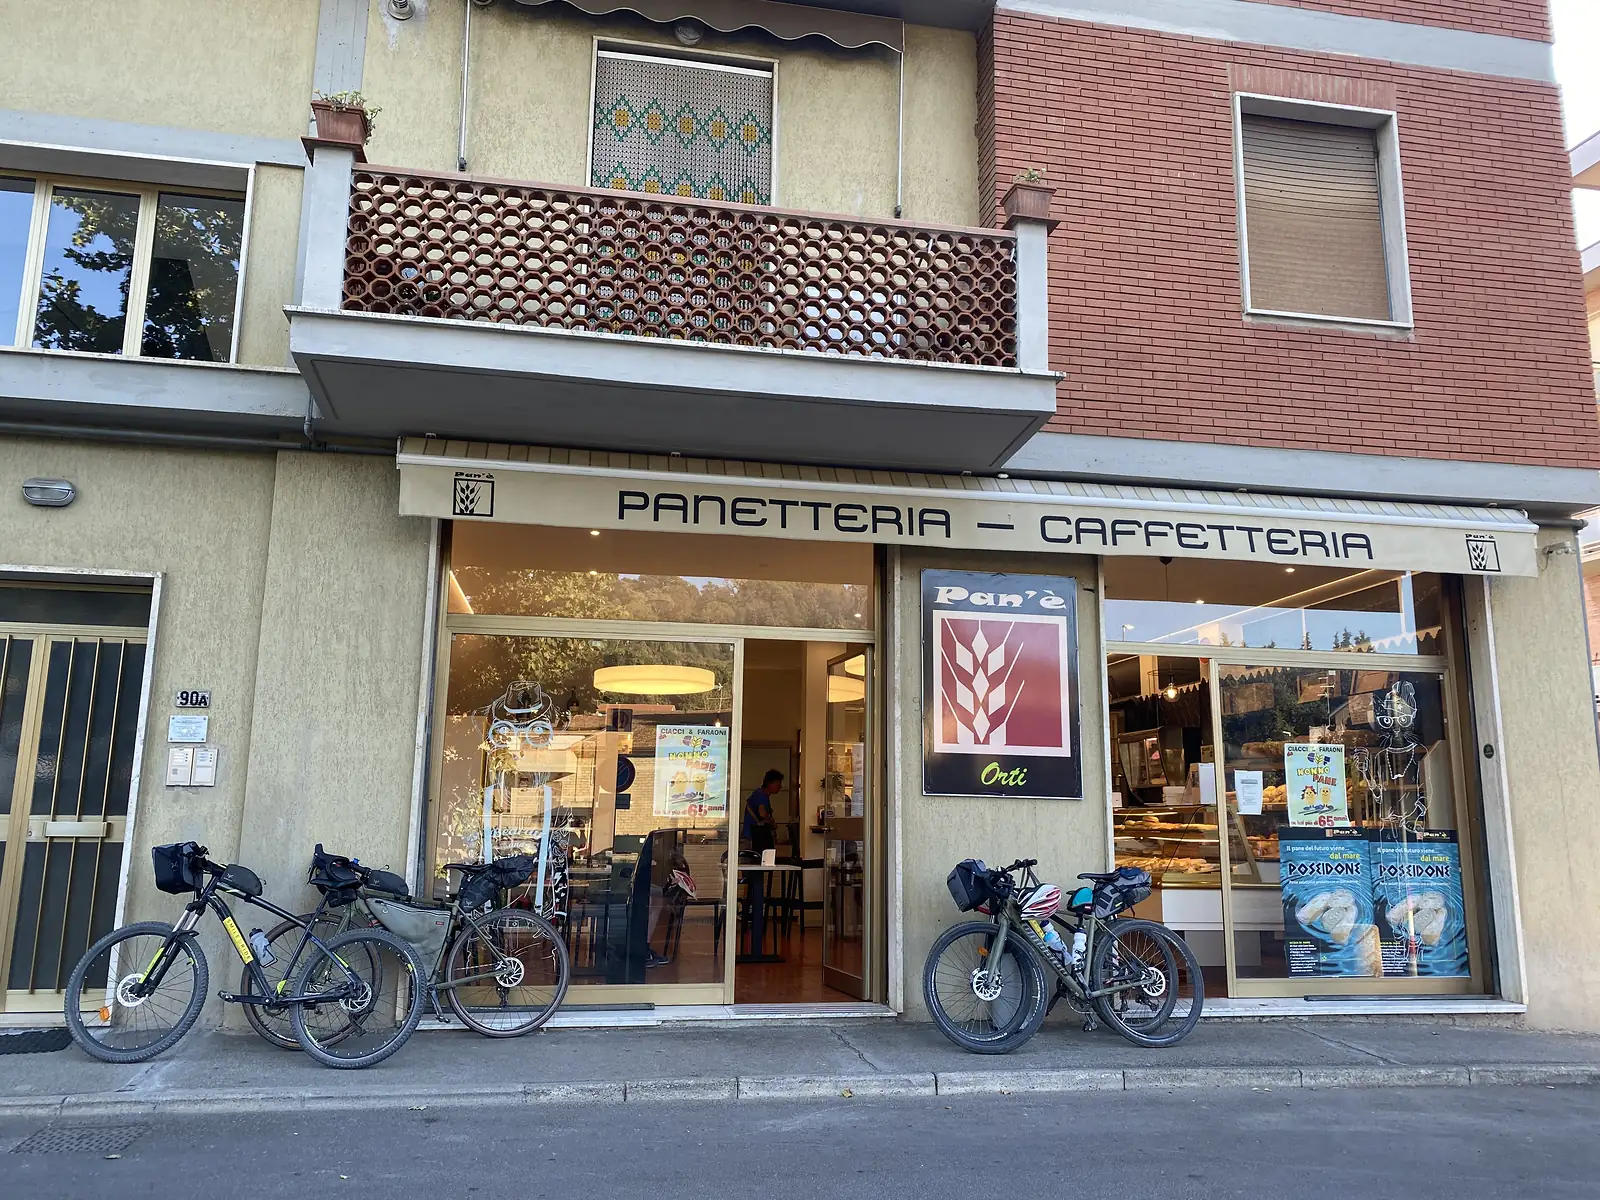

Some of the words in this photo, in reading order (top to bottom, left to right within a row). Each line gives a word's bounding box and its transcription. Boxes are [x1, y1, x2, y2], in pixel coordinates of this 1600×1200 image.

[618, 490, 951, 538] PANETTERIA
[1040, 515, 1374, 560] CAFFETTERIA
[933, 586, 1067, 609] Pan'è
[180, 690, 207, 706] 90A
[668, 750, 709, 761] NONNO
[980, 761, 1028, 787] Orti
[1297, 766, 1330, 776] NONNO
[1312, 773, 1337, 787] PANE
[687, 804, 708, 817] 65
[1318, 815, 1335, 827] 65
[1420, 854, 1431, 862] dal
[1288, 862, 1361, 876] POSEIDONE
[1379, 864, 1451, 877] POSEIDONE
